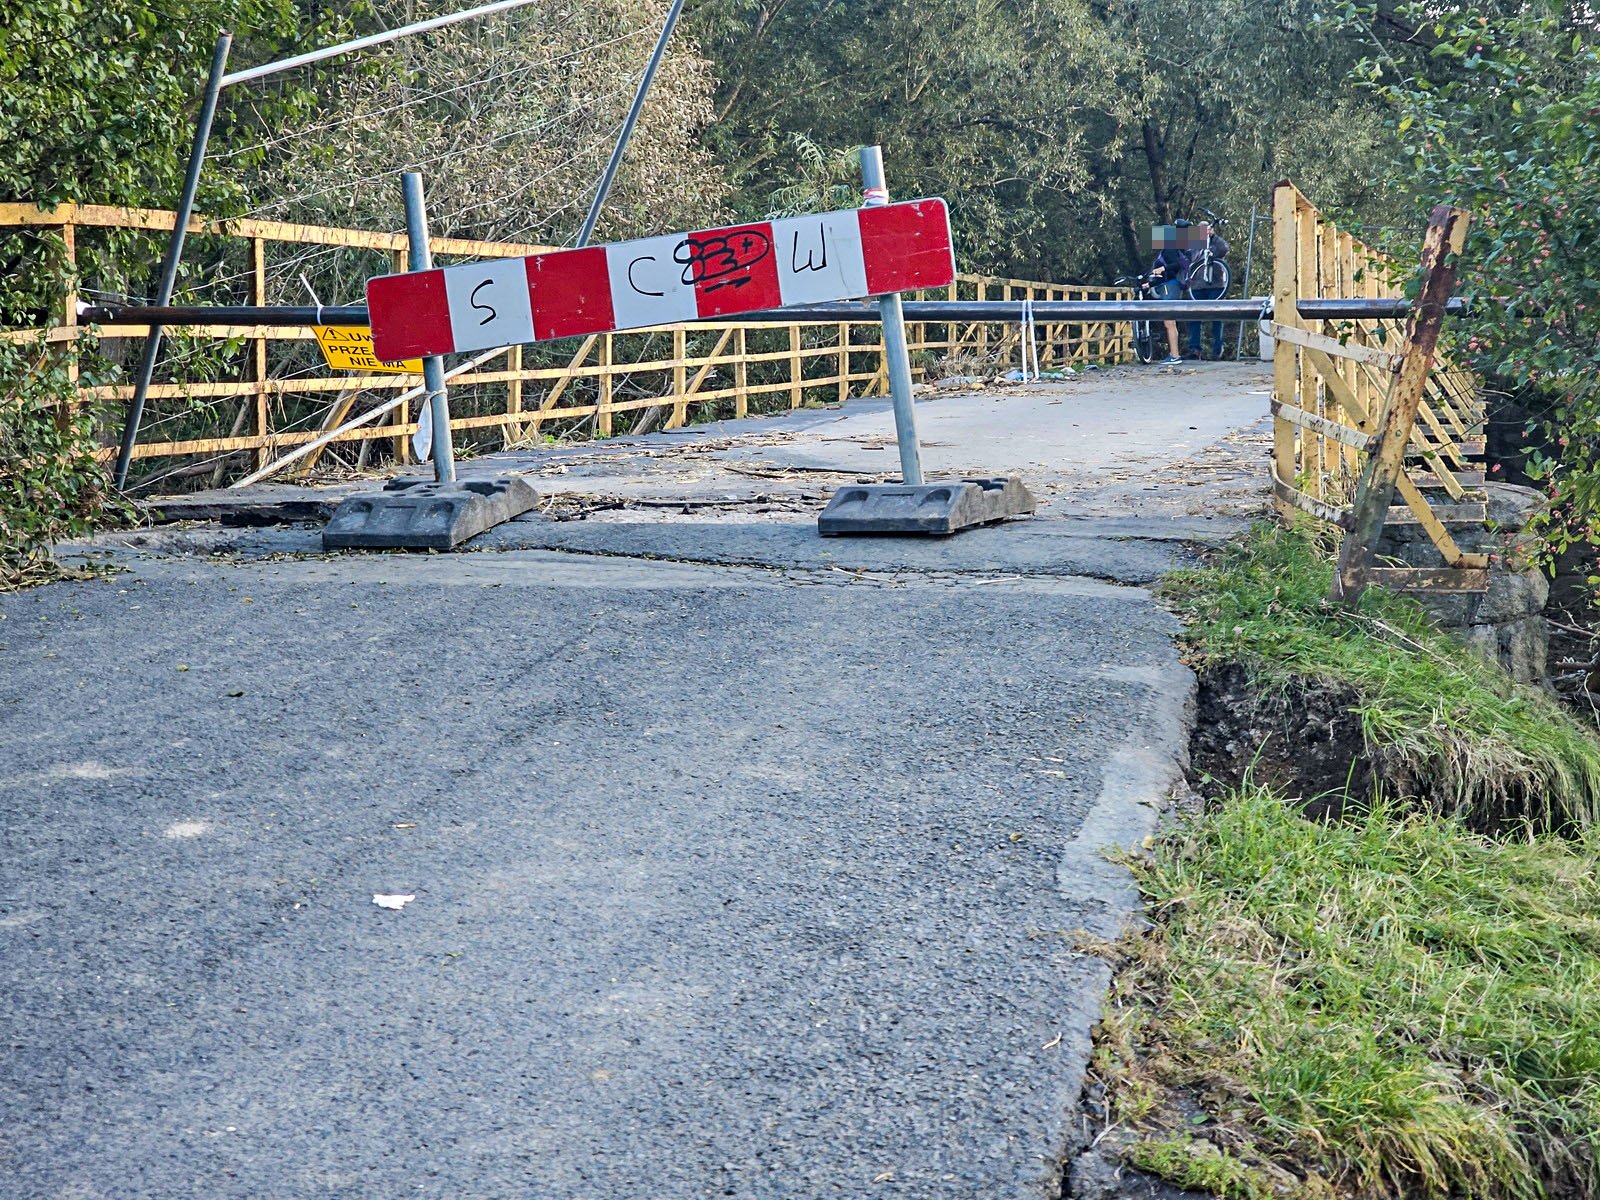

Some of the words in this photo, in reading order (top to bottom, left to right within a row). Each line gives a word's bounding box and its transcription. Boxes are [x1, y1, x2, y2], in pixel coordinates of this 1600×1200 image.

[470, 278, 497, 326] S
[627, 256, 665, 297] C
[327, 345, 375, 356] PRZE
[349, 356, 378, 367] NIE
